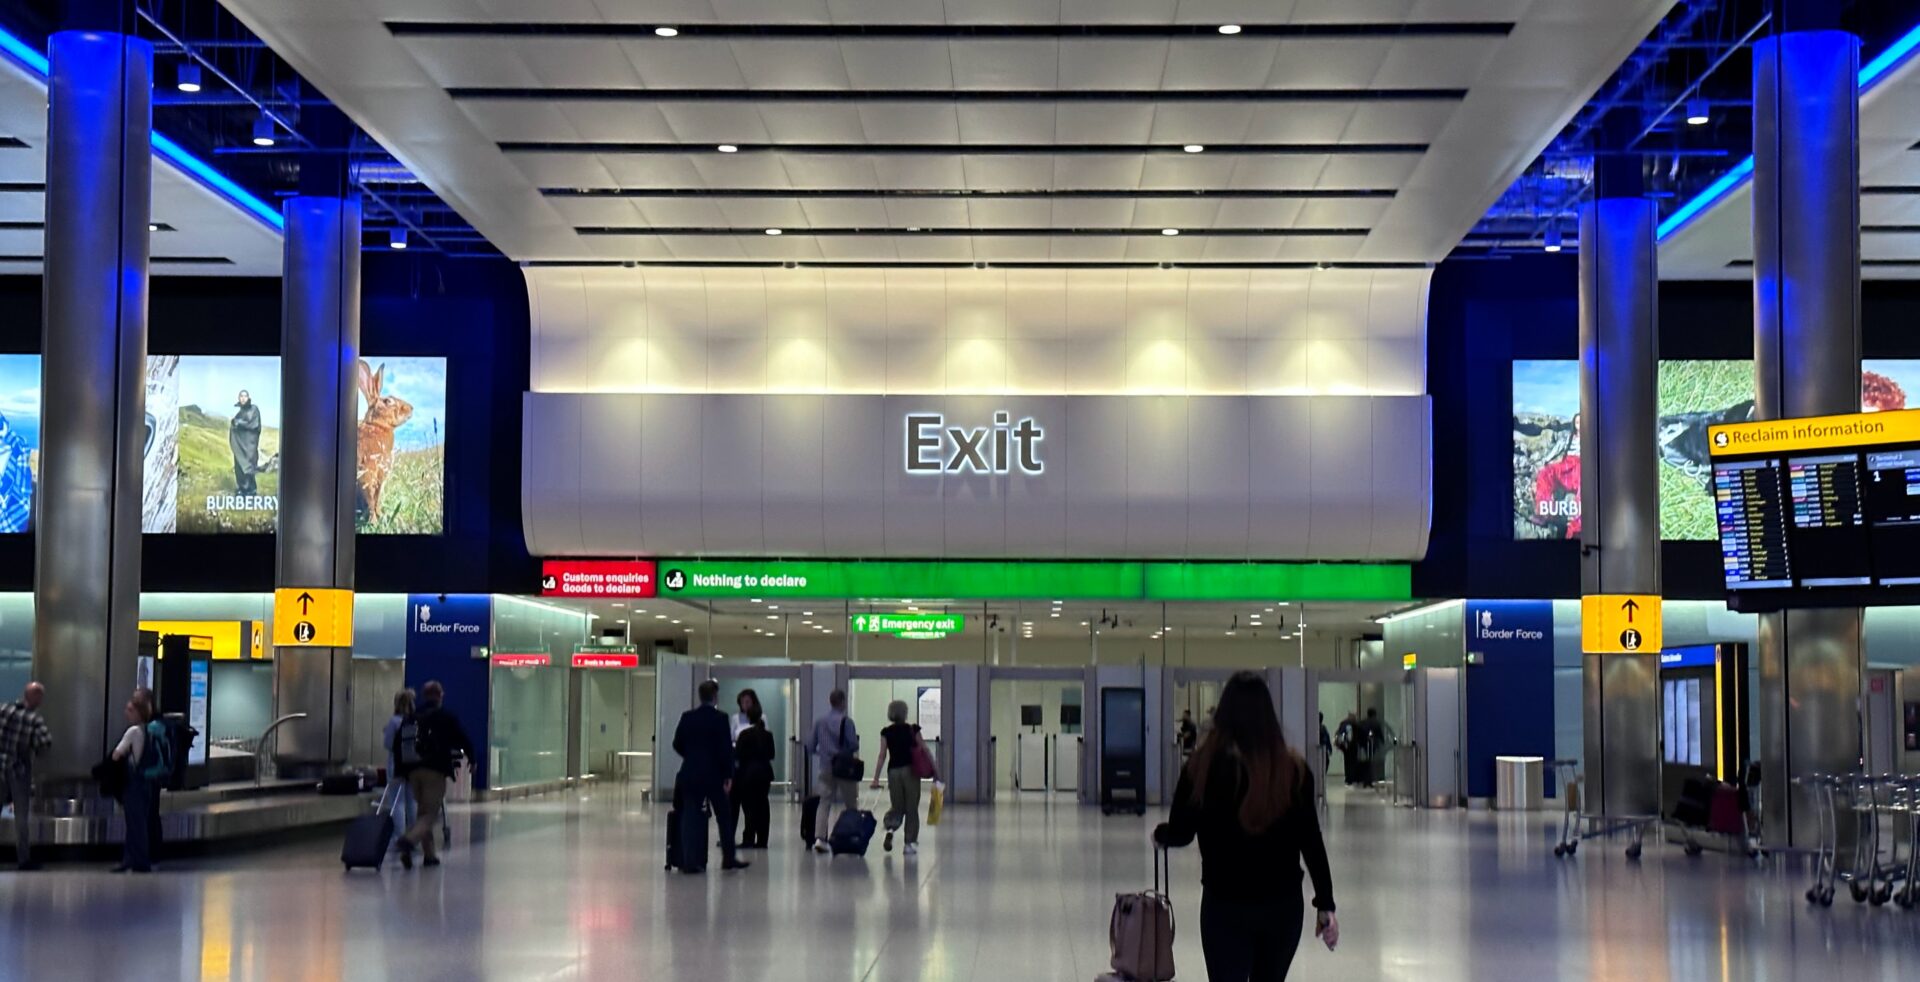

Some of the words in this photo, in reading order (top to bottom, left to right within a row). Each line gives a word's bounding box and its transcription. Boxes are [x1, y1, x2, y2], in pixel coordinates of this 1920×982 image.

[1733, 428, 1788, 444] Reclaim
[1793, 420, 1884, 440] information
[905, 411, 1044, 474] Exit
[1873, 471, 1881, 482] 1
[206, 495, 278, 511] BURBERRY
[563, 573, 604, 582] Customs
[606, 573, 649, 583] enquiries
[693, 574, 742, 589] Nothing
[745, 575, 758, 587] to
[760, 574, 807, 587] declare
[563, 584, 592, 593] Goods
[594, 584, 604, 593] to
[606, 583, 641, 593] declare
[420, 623, 451, 632] Border
[453, 623, 480, 632] Force
[882, 619, 934, 630] Emergency
[936, 619, 955, 629] exit
[1482, 629, 1514, 639] Border
[1516, 629, 1543, 639] Force
